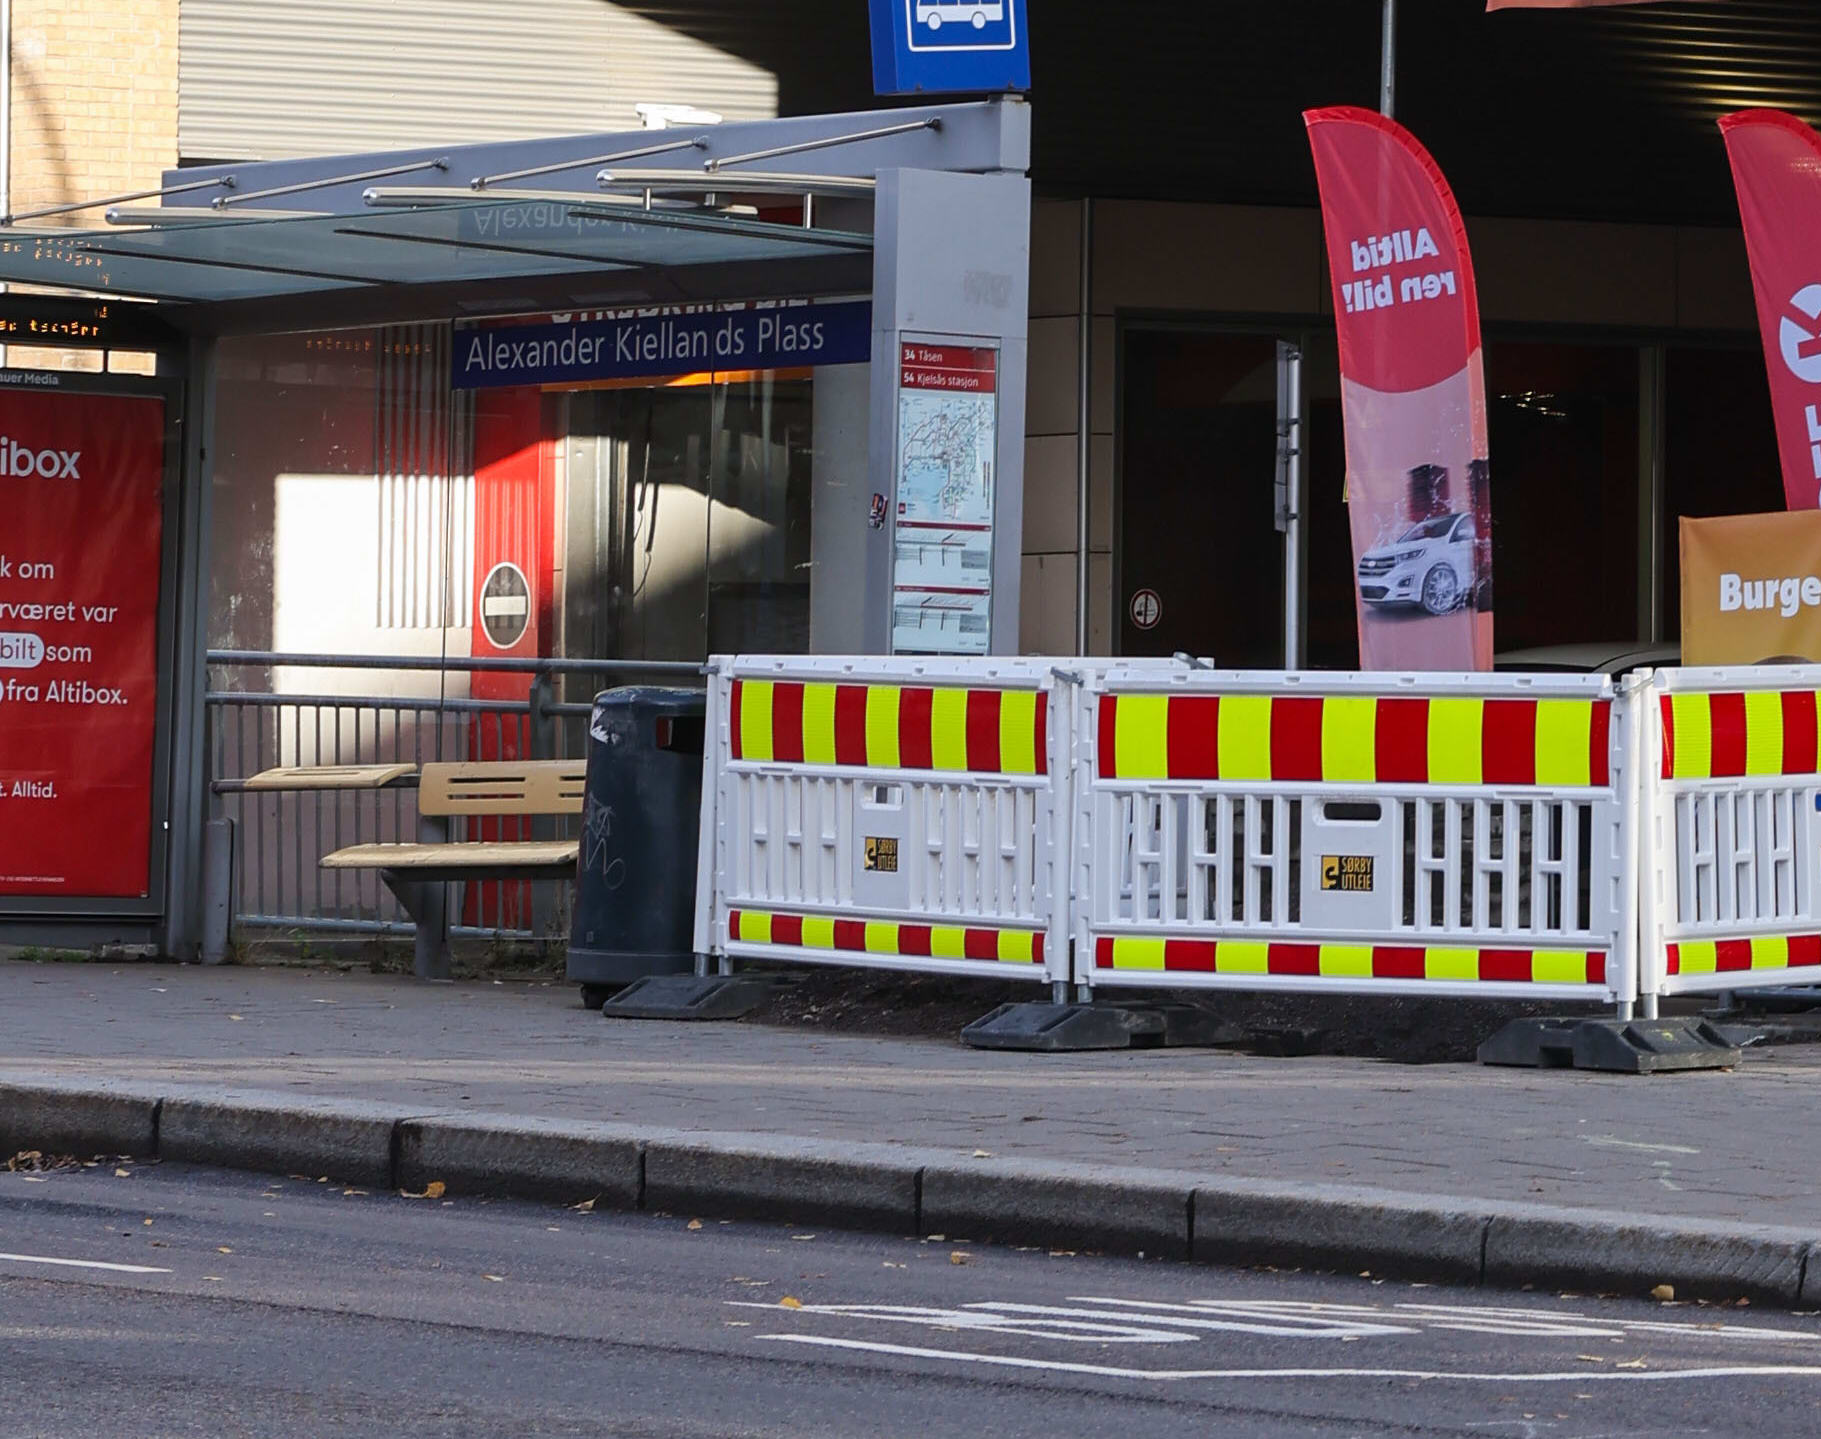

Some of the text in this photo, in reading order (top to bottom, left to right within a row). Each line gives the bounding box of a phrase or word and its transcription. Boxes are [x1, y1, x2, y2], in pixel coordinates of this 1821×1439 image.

[464, 327, 606, 372] Alexander
[614, 319, 746, 362] Kiellands
[757, 315, 825, 353] Plass
[904, 349, 943, 362] 34 Tåsen
[24, 372, 59, 385] Media
[904, 372, 979, 389] 54 Kjelsås stasjon
[18, 561, 55, 579] om
[82, 606, 118, 623] var
[46, 645, 92, 663] som
[7, 678, 129, 705] fra Altibox.
[11, 780, 58, 798] Alltid.
[1341, 856, 1372, 873] SØRBY
[1341, 873, 1372, 890] UTLEIE
